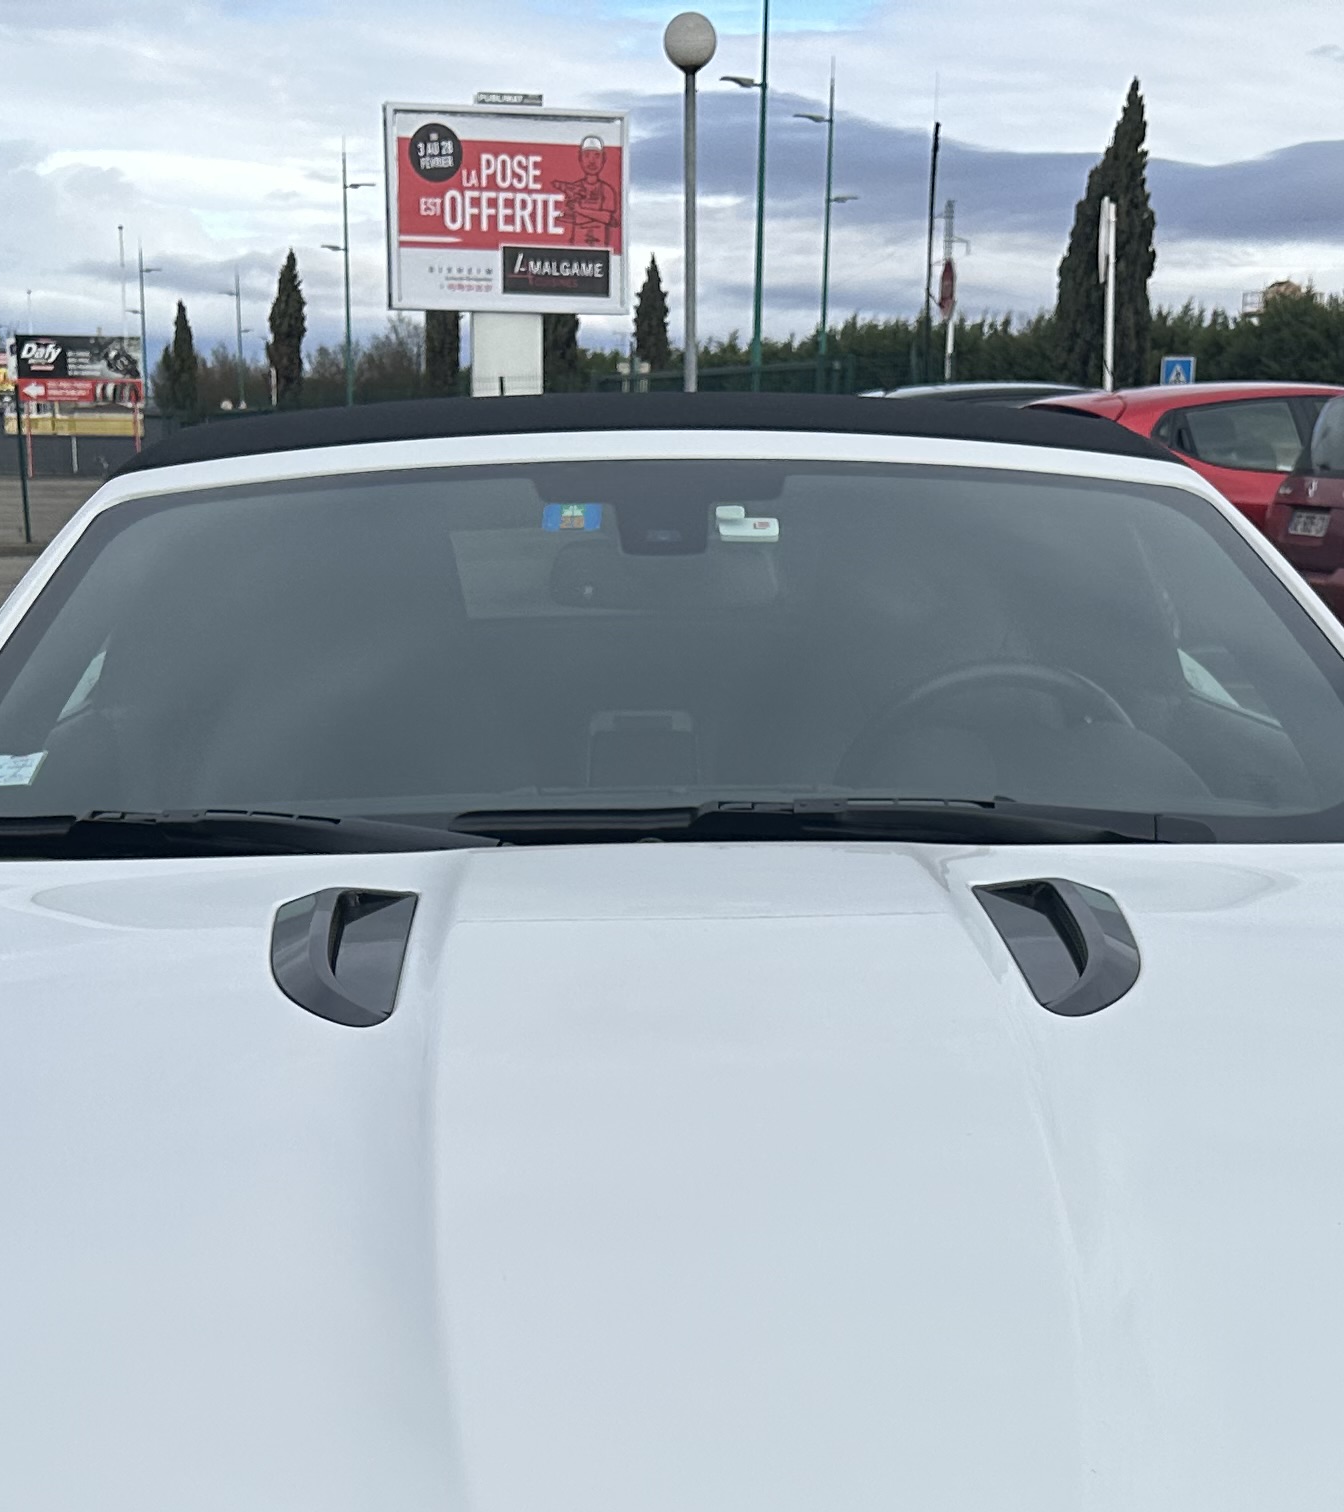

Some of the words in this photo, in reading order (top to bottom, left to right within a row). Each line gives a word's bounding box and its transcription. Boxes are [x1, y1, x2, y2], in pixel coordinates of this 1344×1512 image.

[417, 142, 425, 156] 3
[426, 142, 440, 155] AU
[461, 169, 480, 188] LA
[480, 153, 543, 190] POSE
[419, 198, 441, 216] EST
[443, 189, 565, 235] OFFERTE
[21, 342, 61, 364] Dafy
